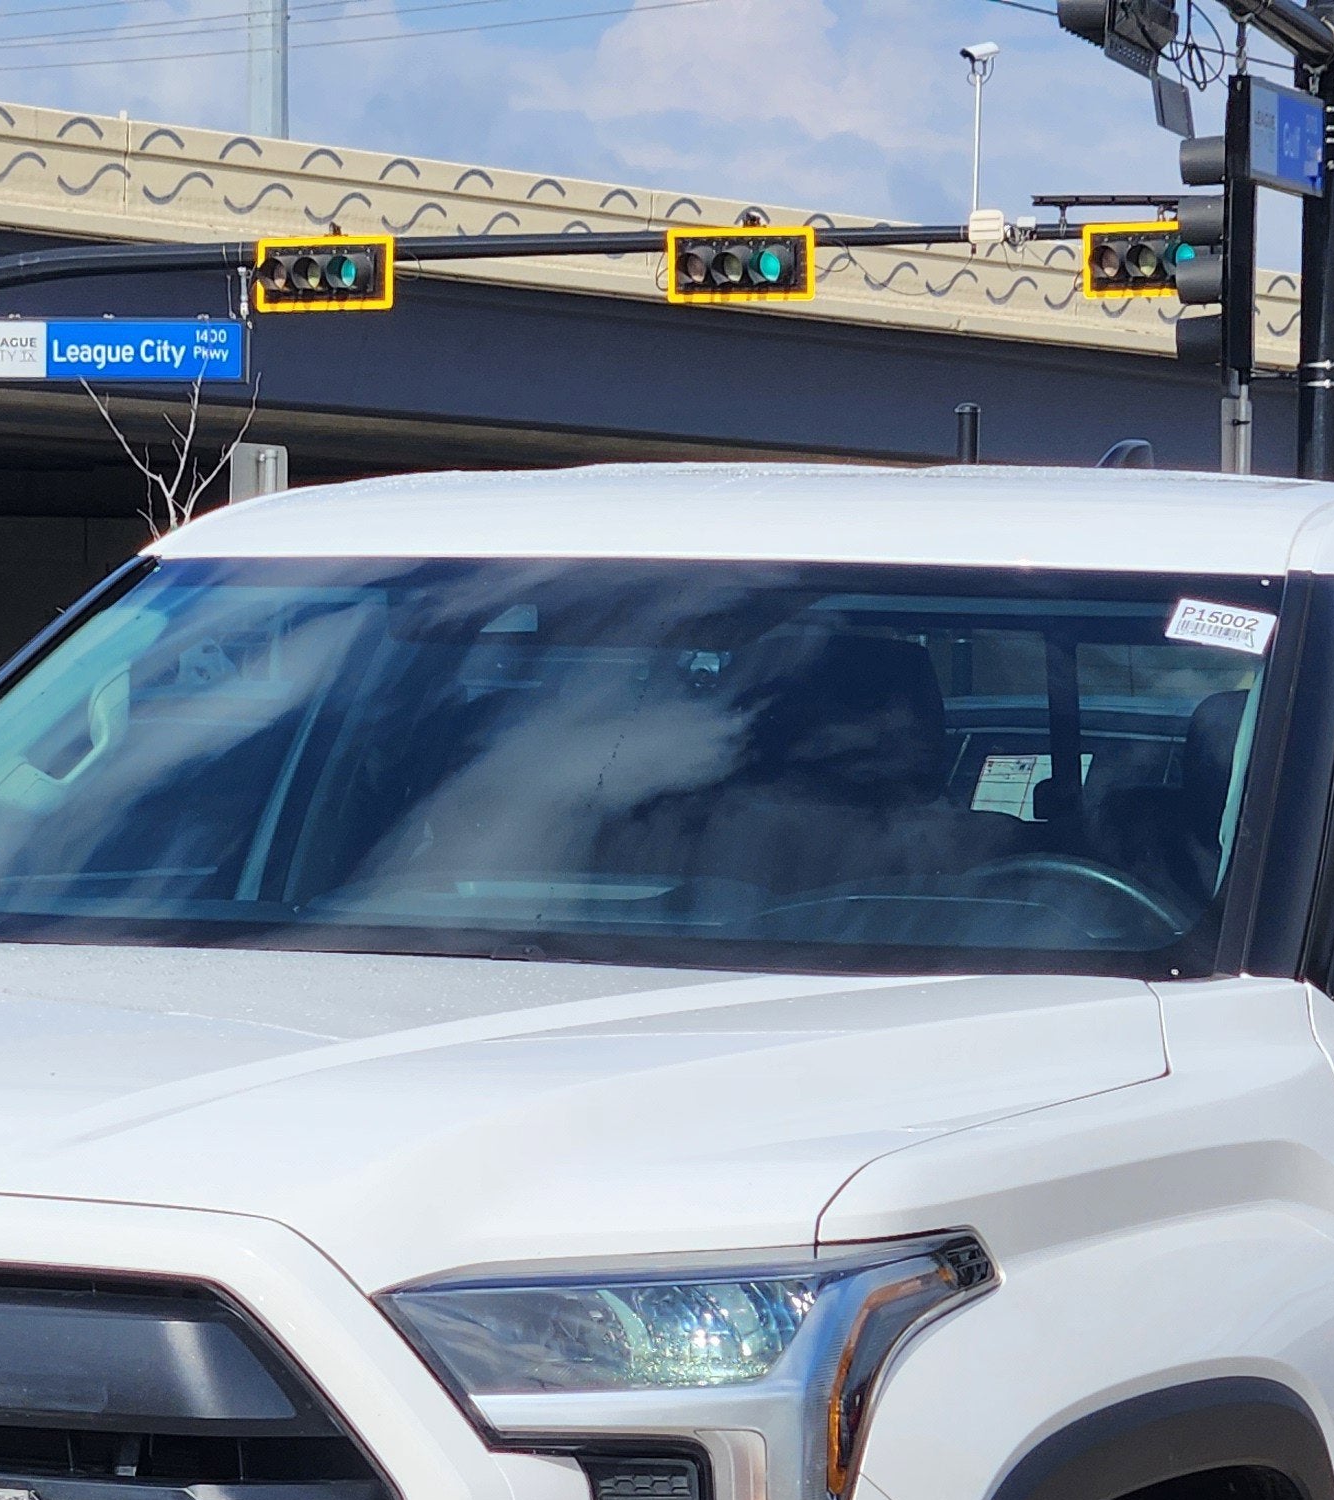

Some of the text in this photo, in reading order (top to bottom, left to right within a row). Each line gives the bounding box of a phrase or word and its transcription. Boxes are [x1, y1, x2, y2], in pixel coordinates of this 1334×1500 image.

[52, 339, 186, 370] League City
[193, 345, 229, 362] Pkwy
[1181, 606, 1259, 631] P15002
